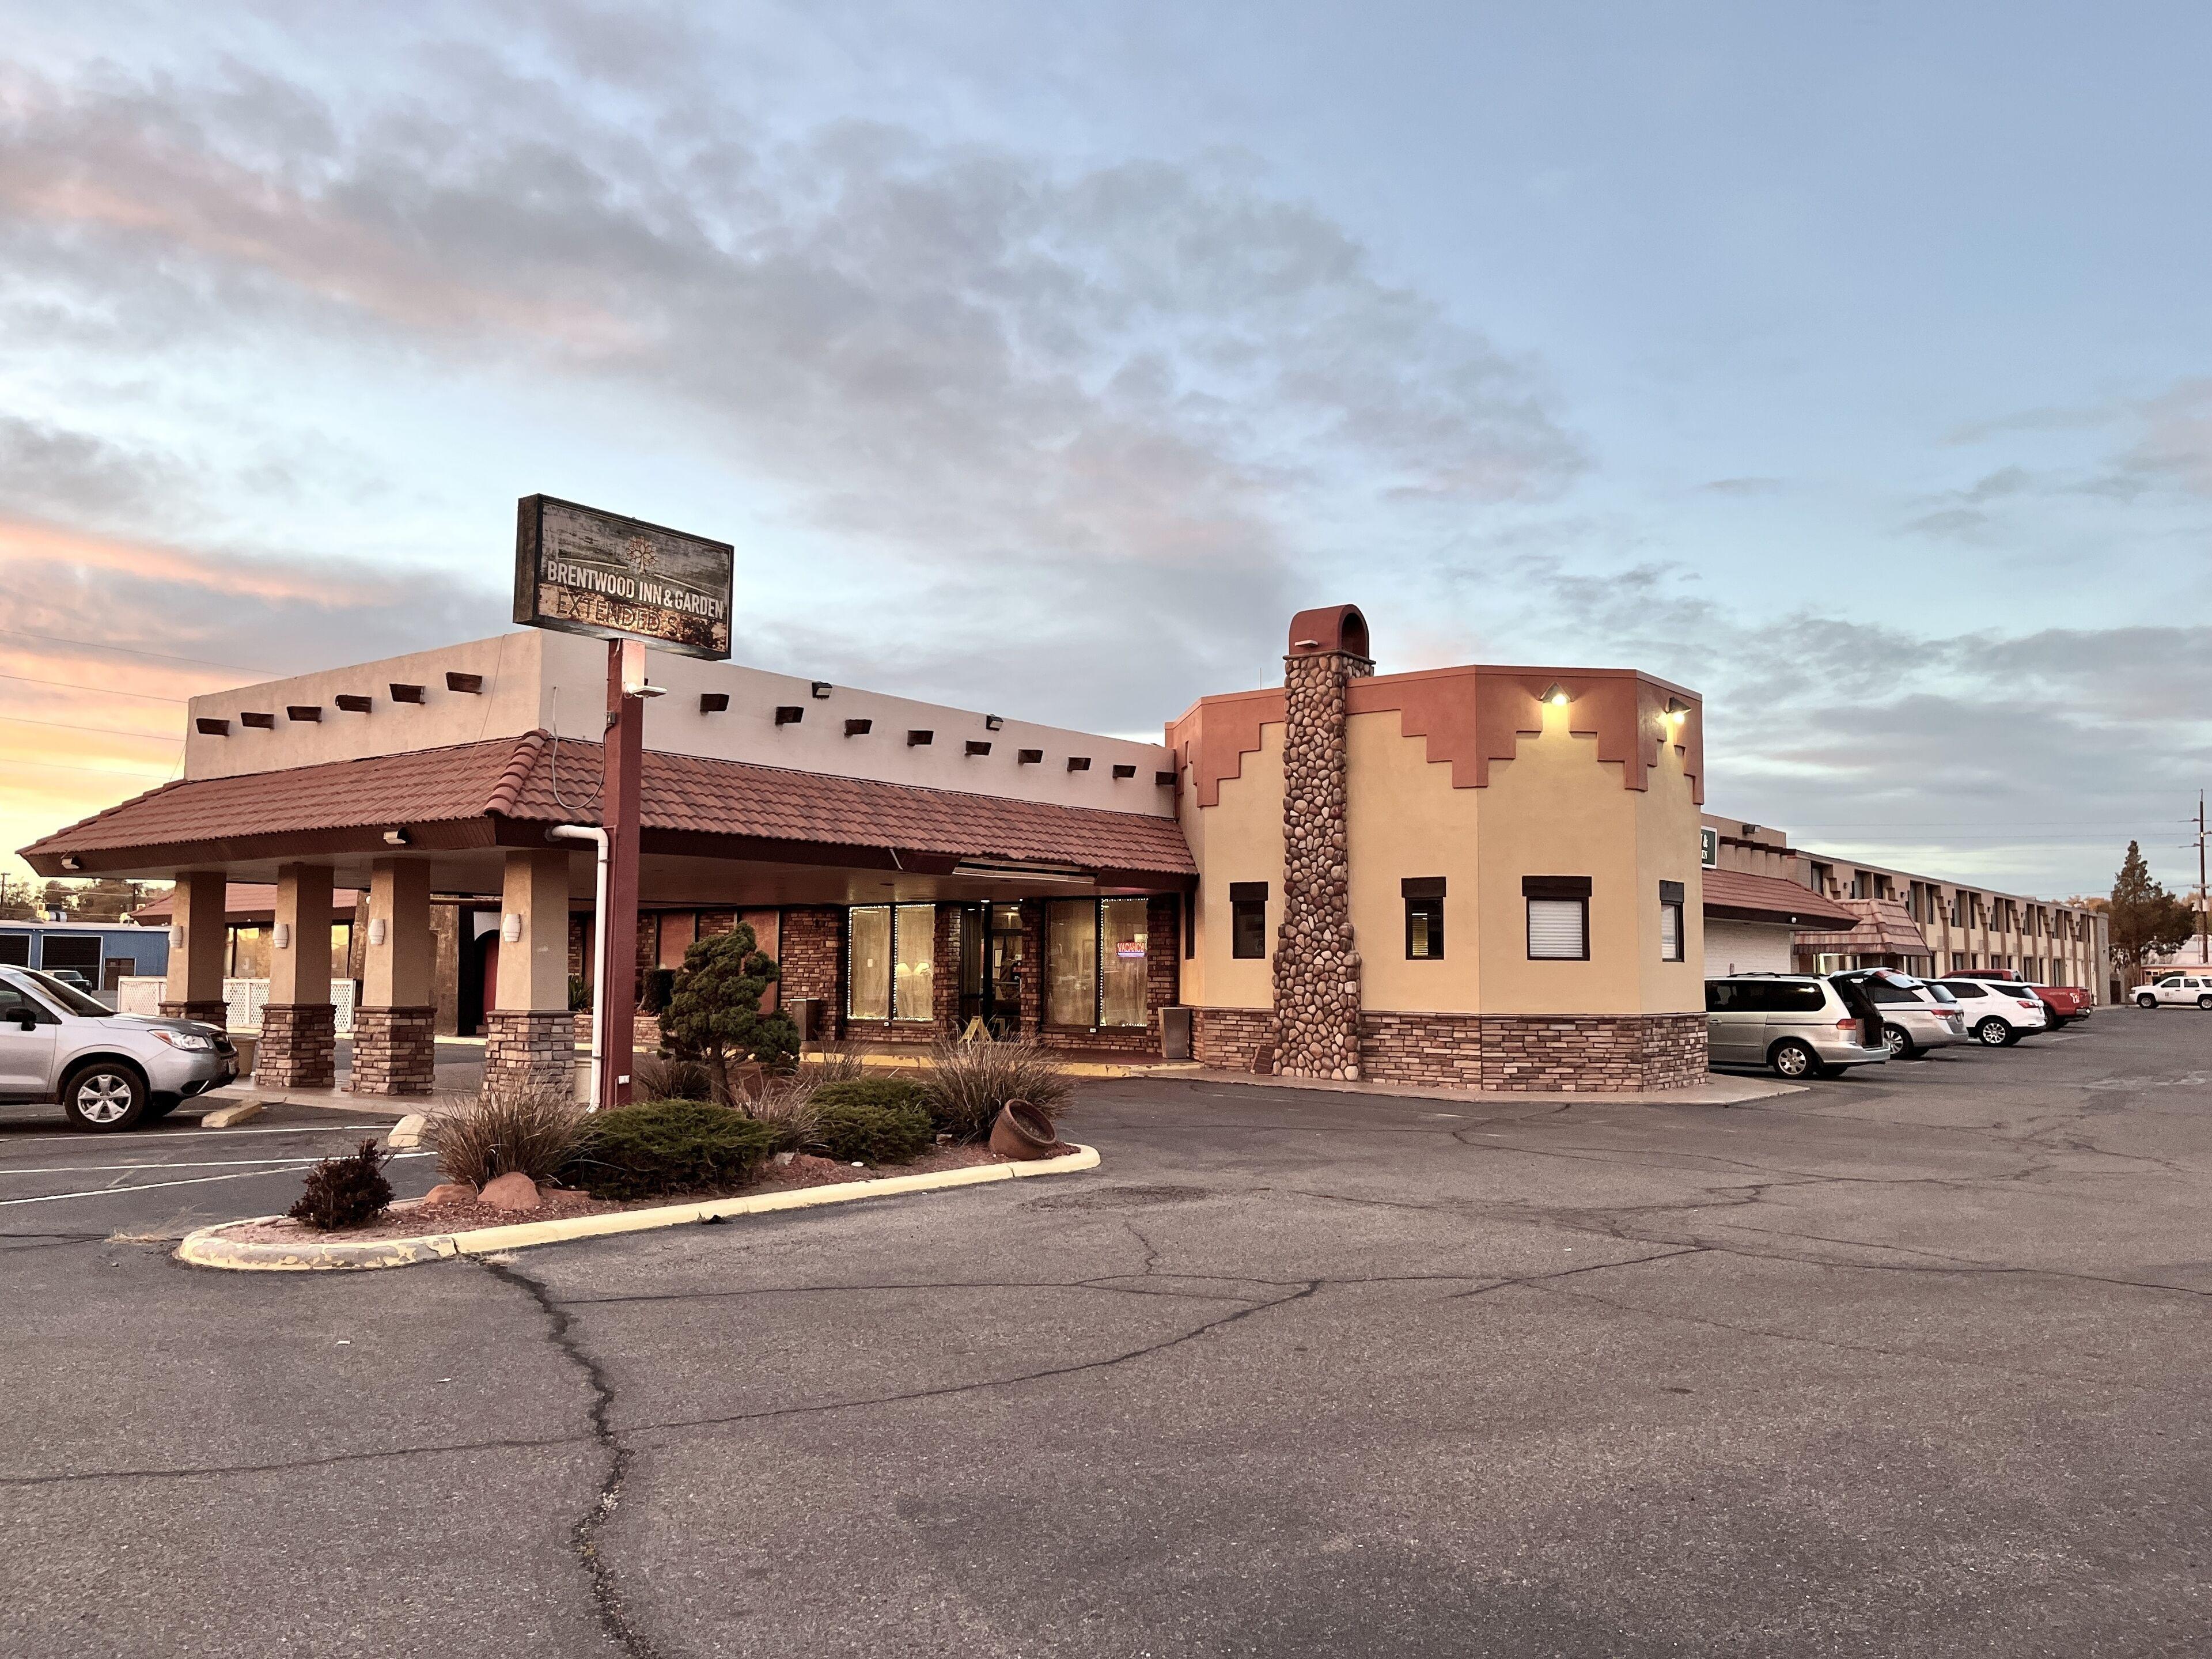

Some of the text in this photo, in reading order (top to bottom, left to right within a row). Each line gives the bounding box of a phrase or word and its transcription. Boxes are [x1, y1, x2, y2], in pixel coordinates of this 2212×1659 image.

[548, 561, 724, 619] BRENTWOOD INN & GARDEN
[556, 591, 661, 631] EXTENDED
[1118, 942, 1145, 952] VACANCY
